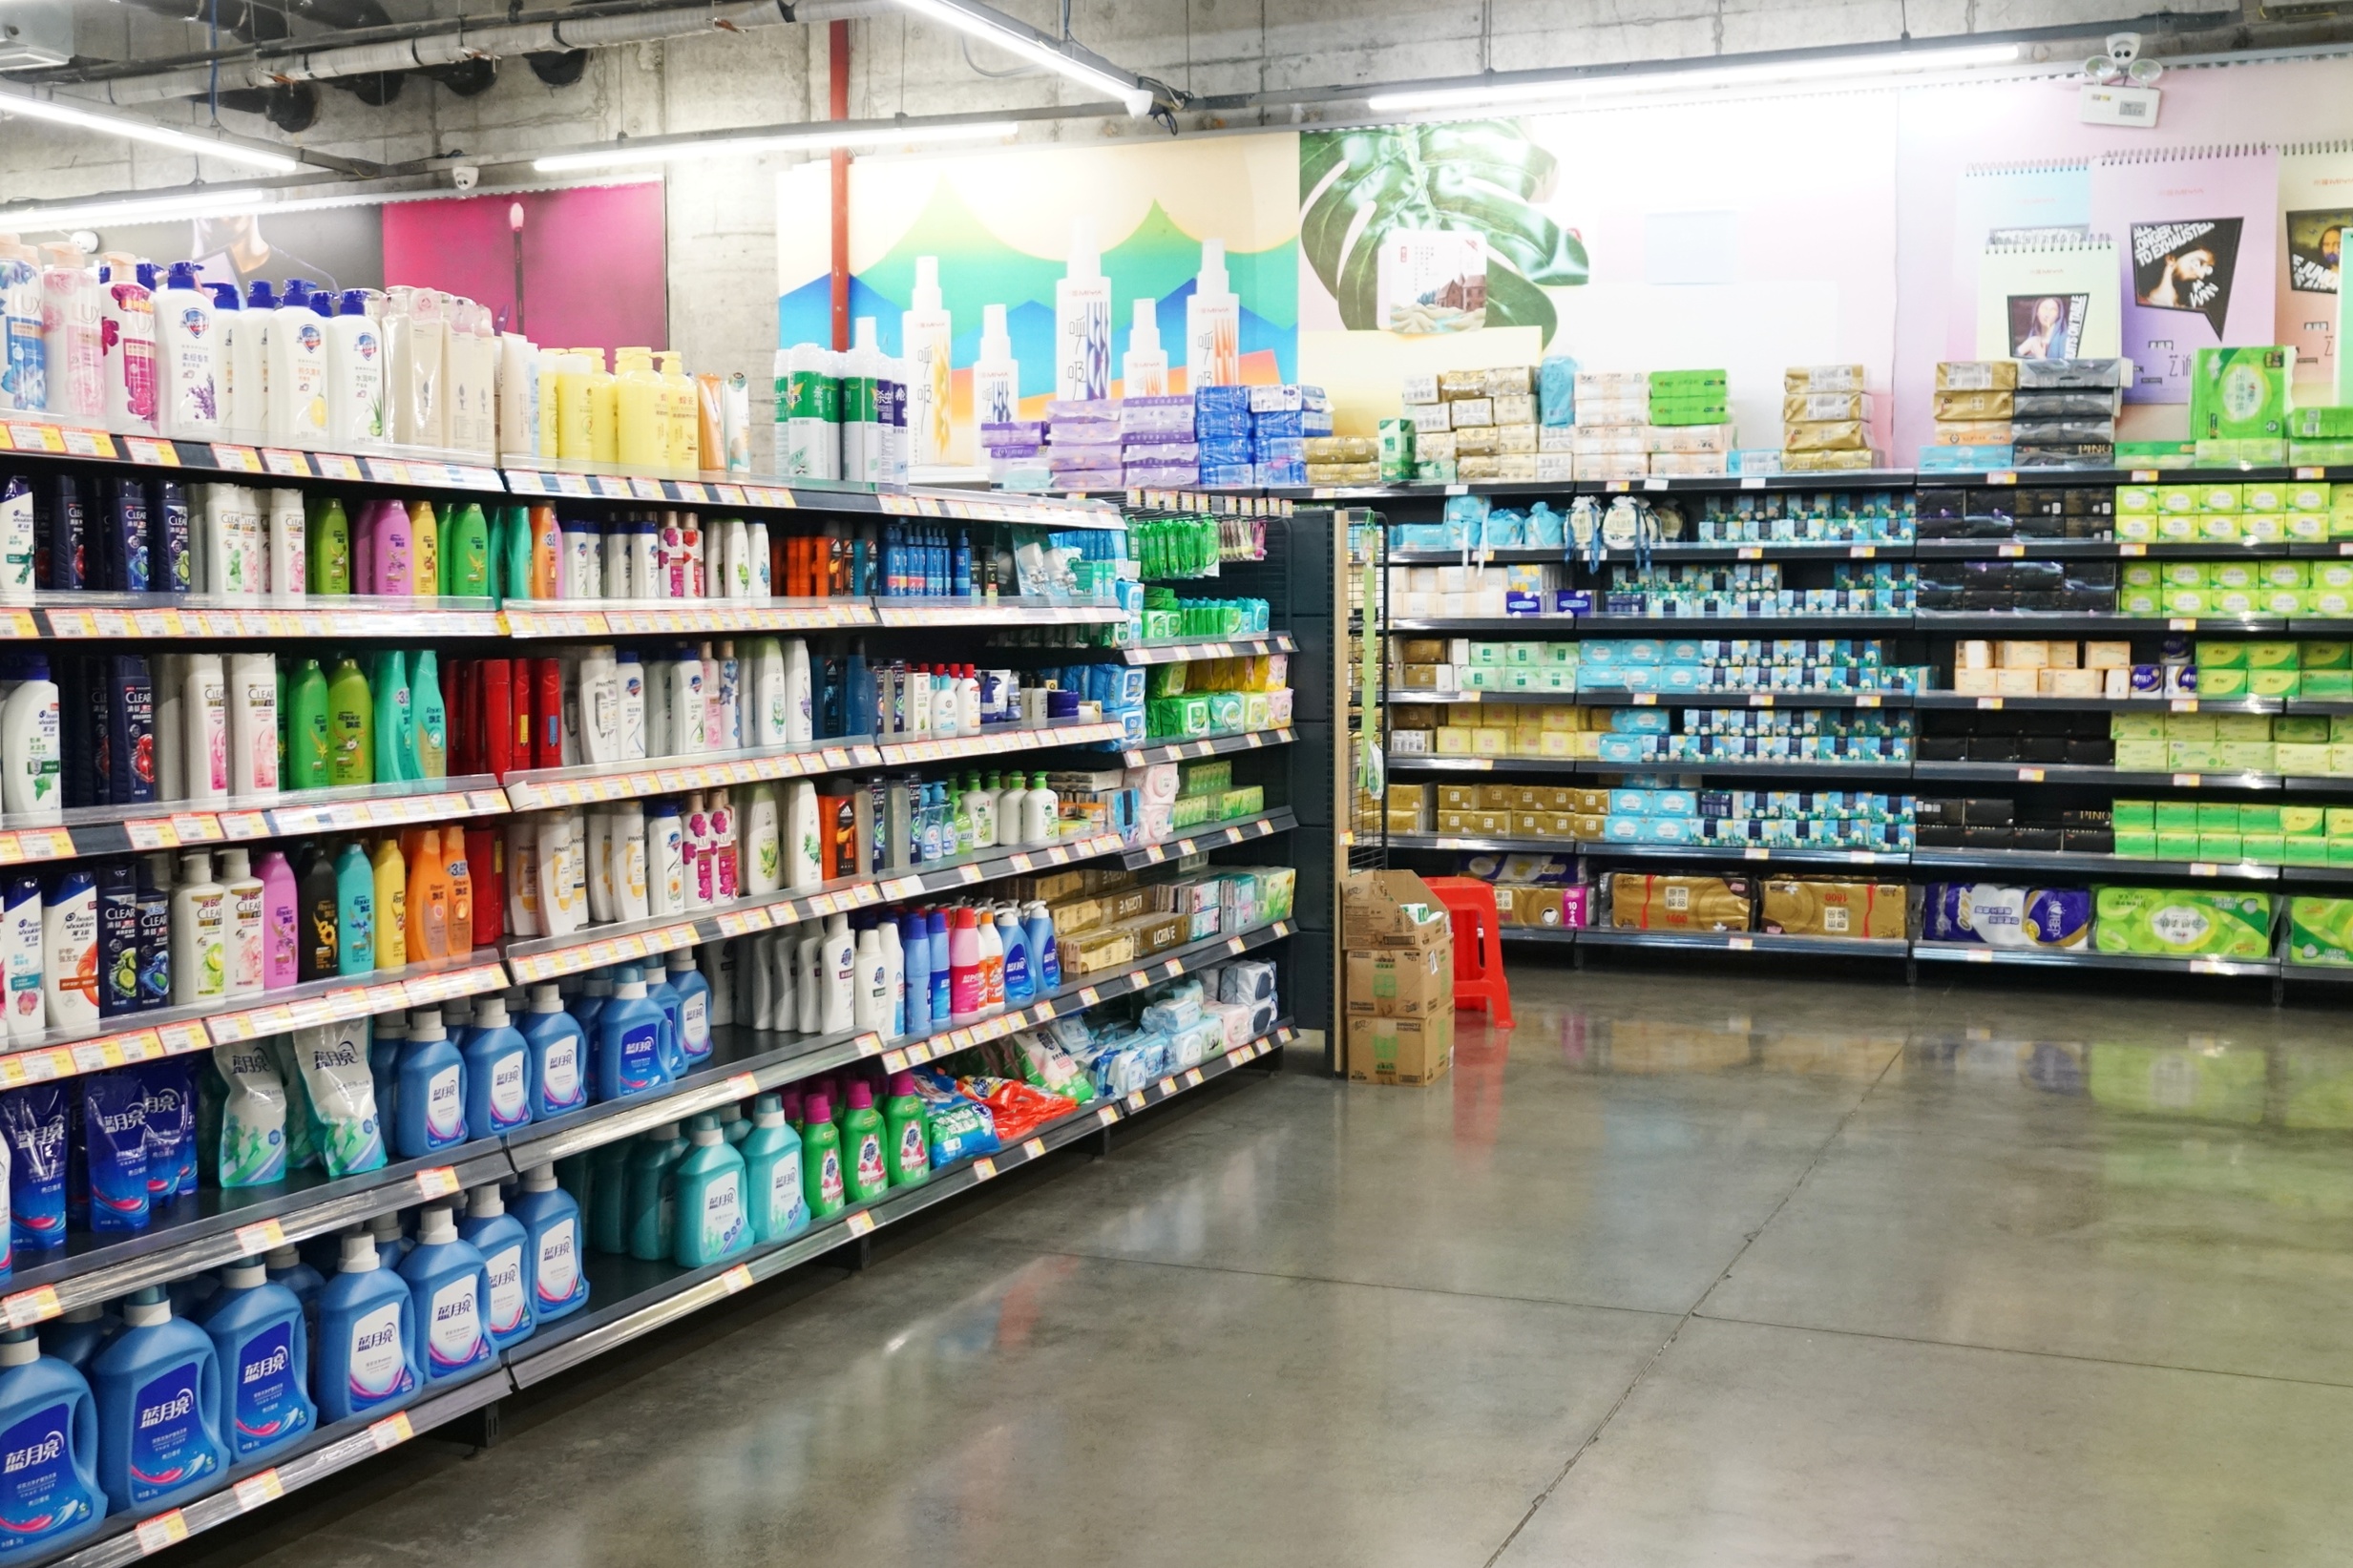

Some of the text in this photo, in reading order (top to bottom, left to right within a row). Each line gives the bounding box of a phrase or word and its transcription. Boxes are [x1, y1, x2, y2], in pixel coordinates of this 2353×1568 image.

[1567, 901, 1578, 910] 10
[232, 1049, 271, 1075] 蓝月亮
[313, 1044, 359, 1071] 蓝月亮
[549, 1050, 574, 1070] 蓝月亮
[104, 1107, 146, 1134] 蓝月亮
[543, 1238, 572, 1262] 蓝月亮
[436, 1295, 473, 1322] 蓝月亮
[356, 1325, 395, 1352] 蓝月亮
[242, 1348, 288, 1385] 蓝月亮
[140, 1390, 193, 1430] 蓝月亮
[3, 1433, 63, 1474] 蓝月亮
